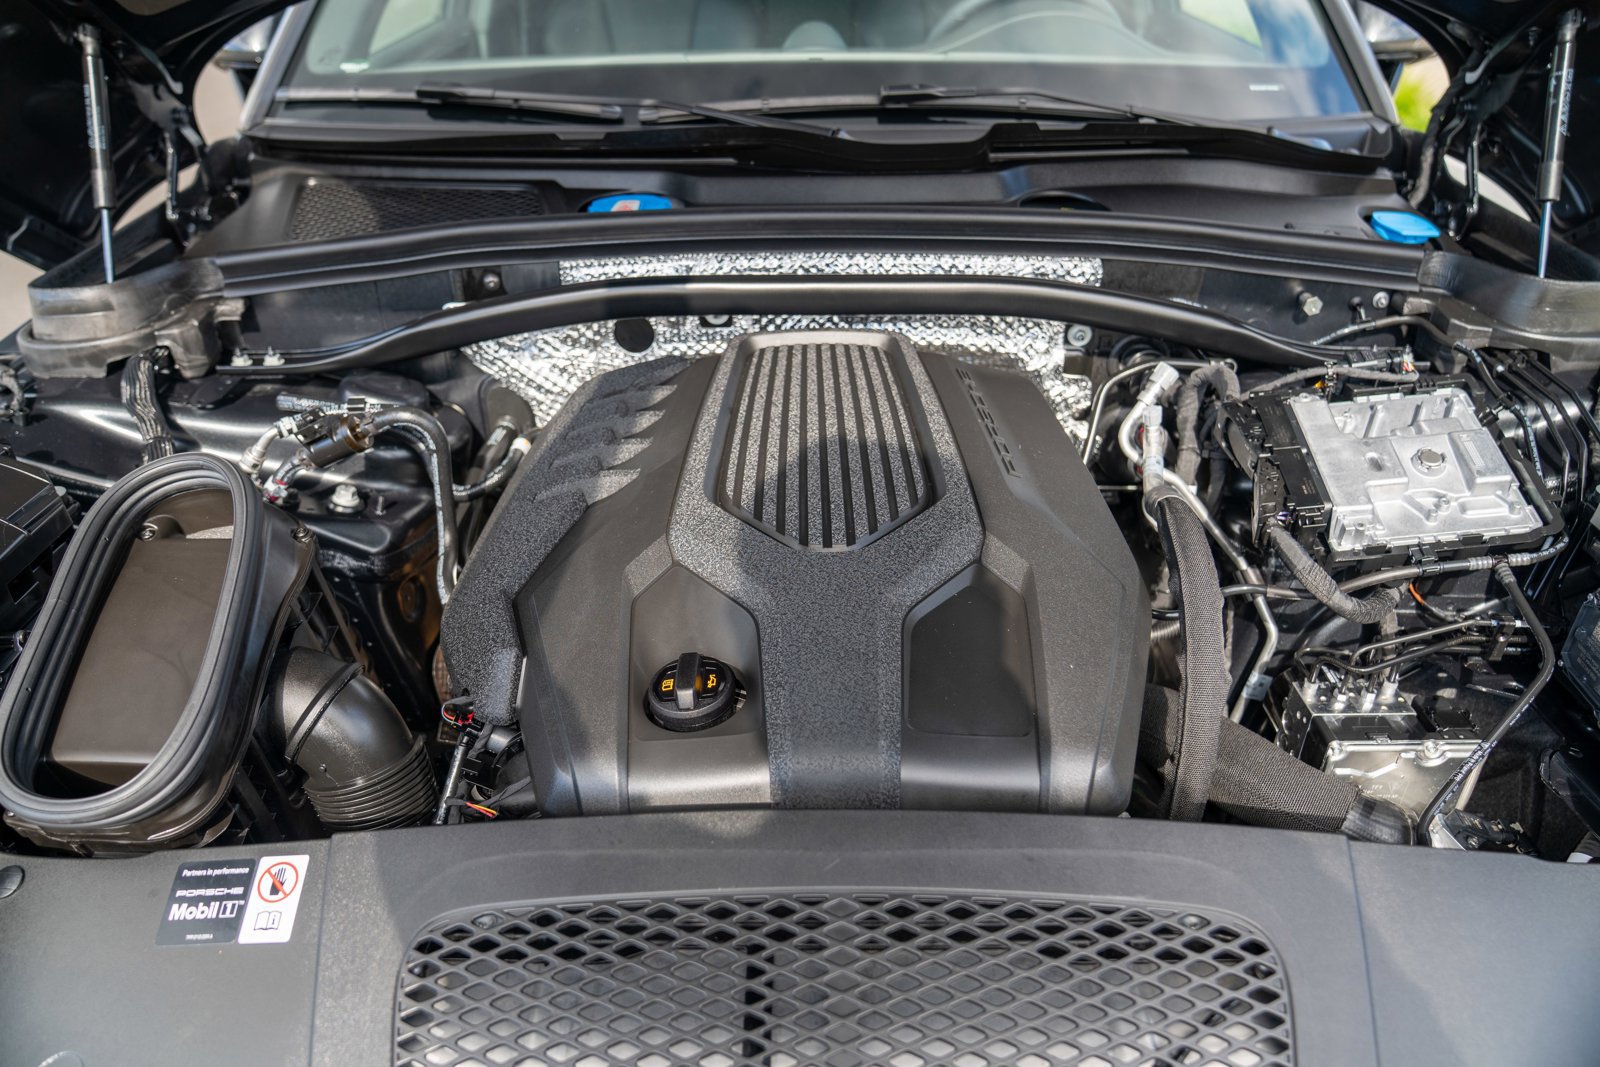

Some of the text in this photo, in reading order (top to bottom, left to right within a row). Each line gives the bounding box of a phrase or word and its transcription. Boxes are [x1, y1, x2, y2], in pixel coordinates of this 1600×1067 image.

[954, 367, 1023, 479] PORSCHE
[212, 868, 250, 876] performance
[176, 887, 245, 897] PORSCHE
[168, 902, 220, 920] Mobil
